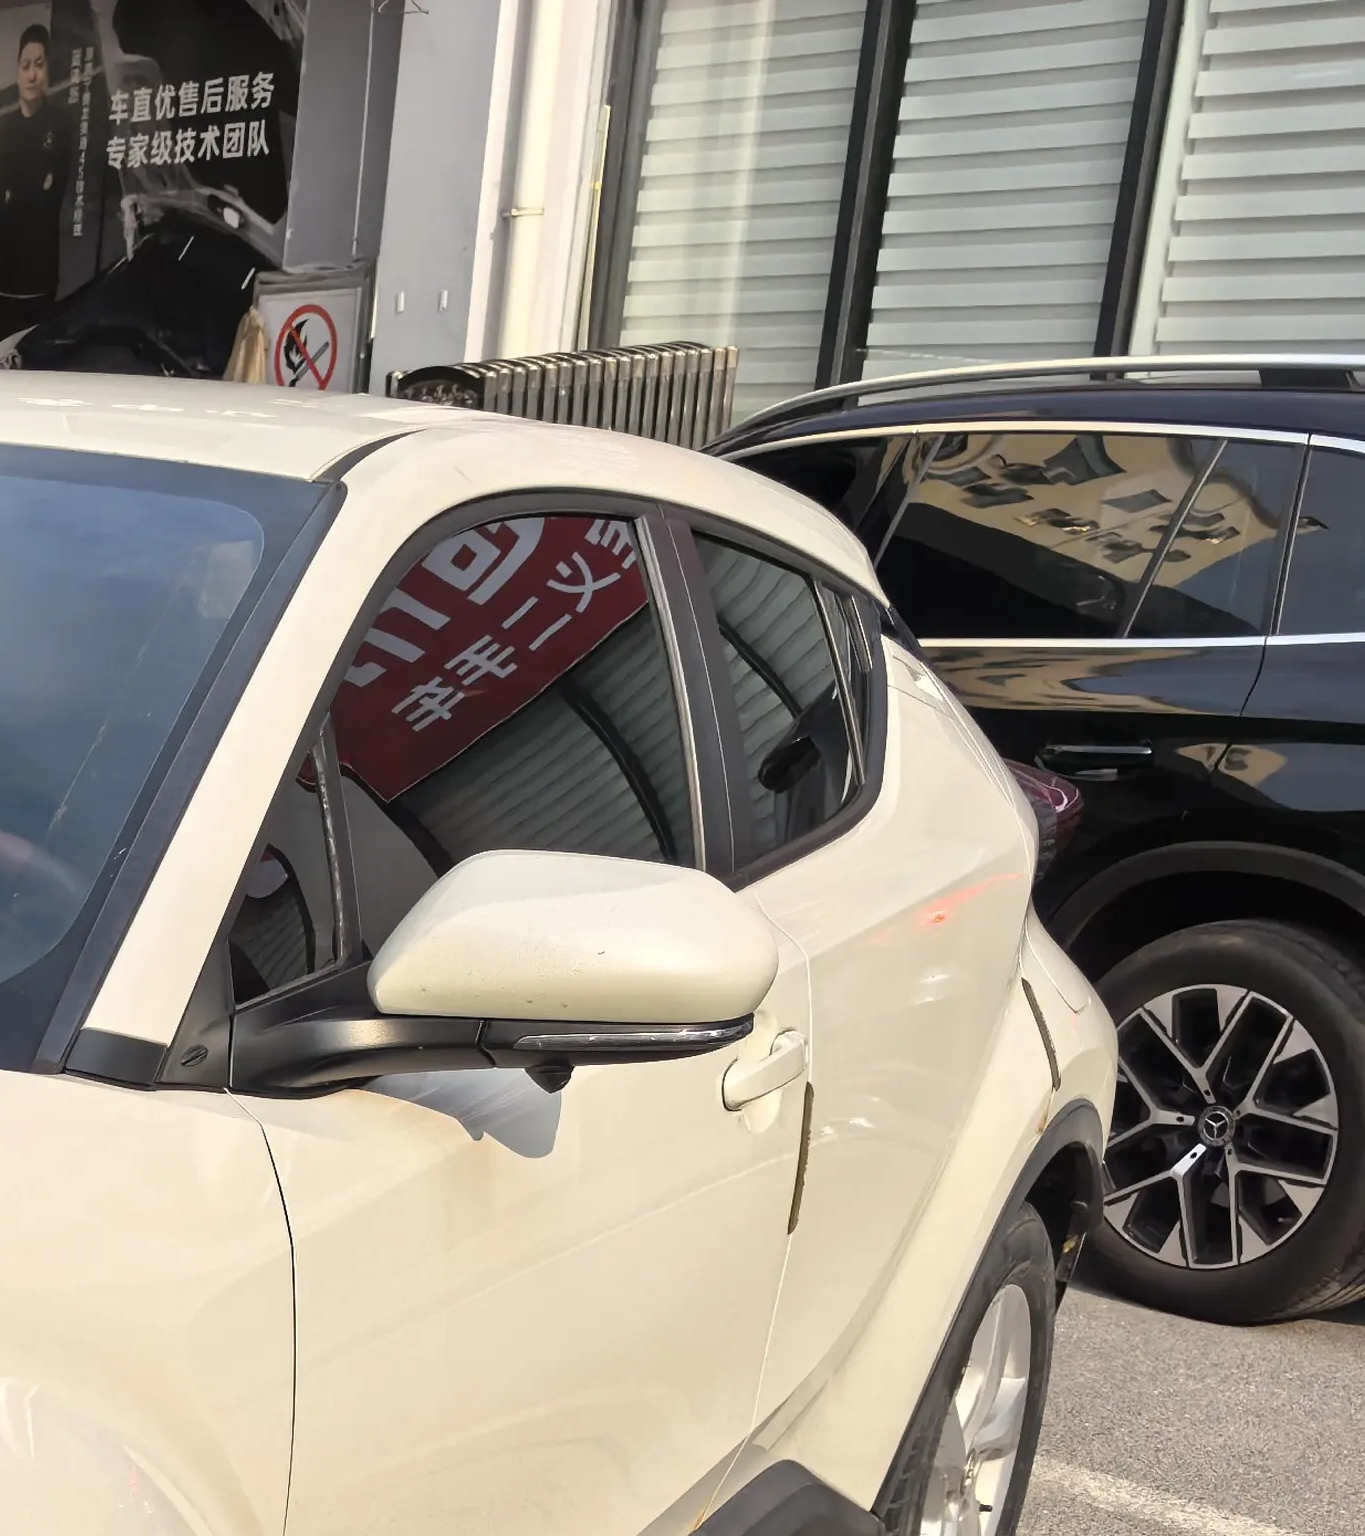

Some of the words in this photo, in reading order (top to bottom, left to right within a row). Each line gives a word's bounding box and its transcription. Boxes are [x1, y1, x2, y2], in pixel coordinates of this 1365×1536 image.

[108, 71, 275, 126] 车直优售后服务
[105, 119, 270, 170] 专家级技术团队
